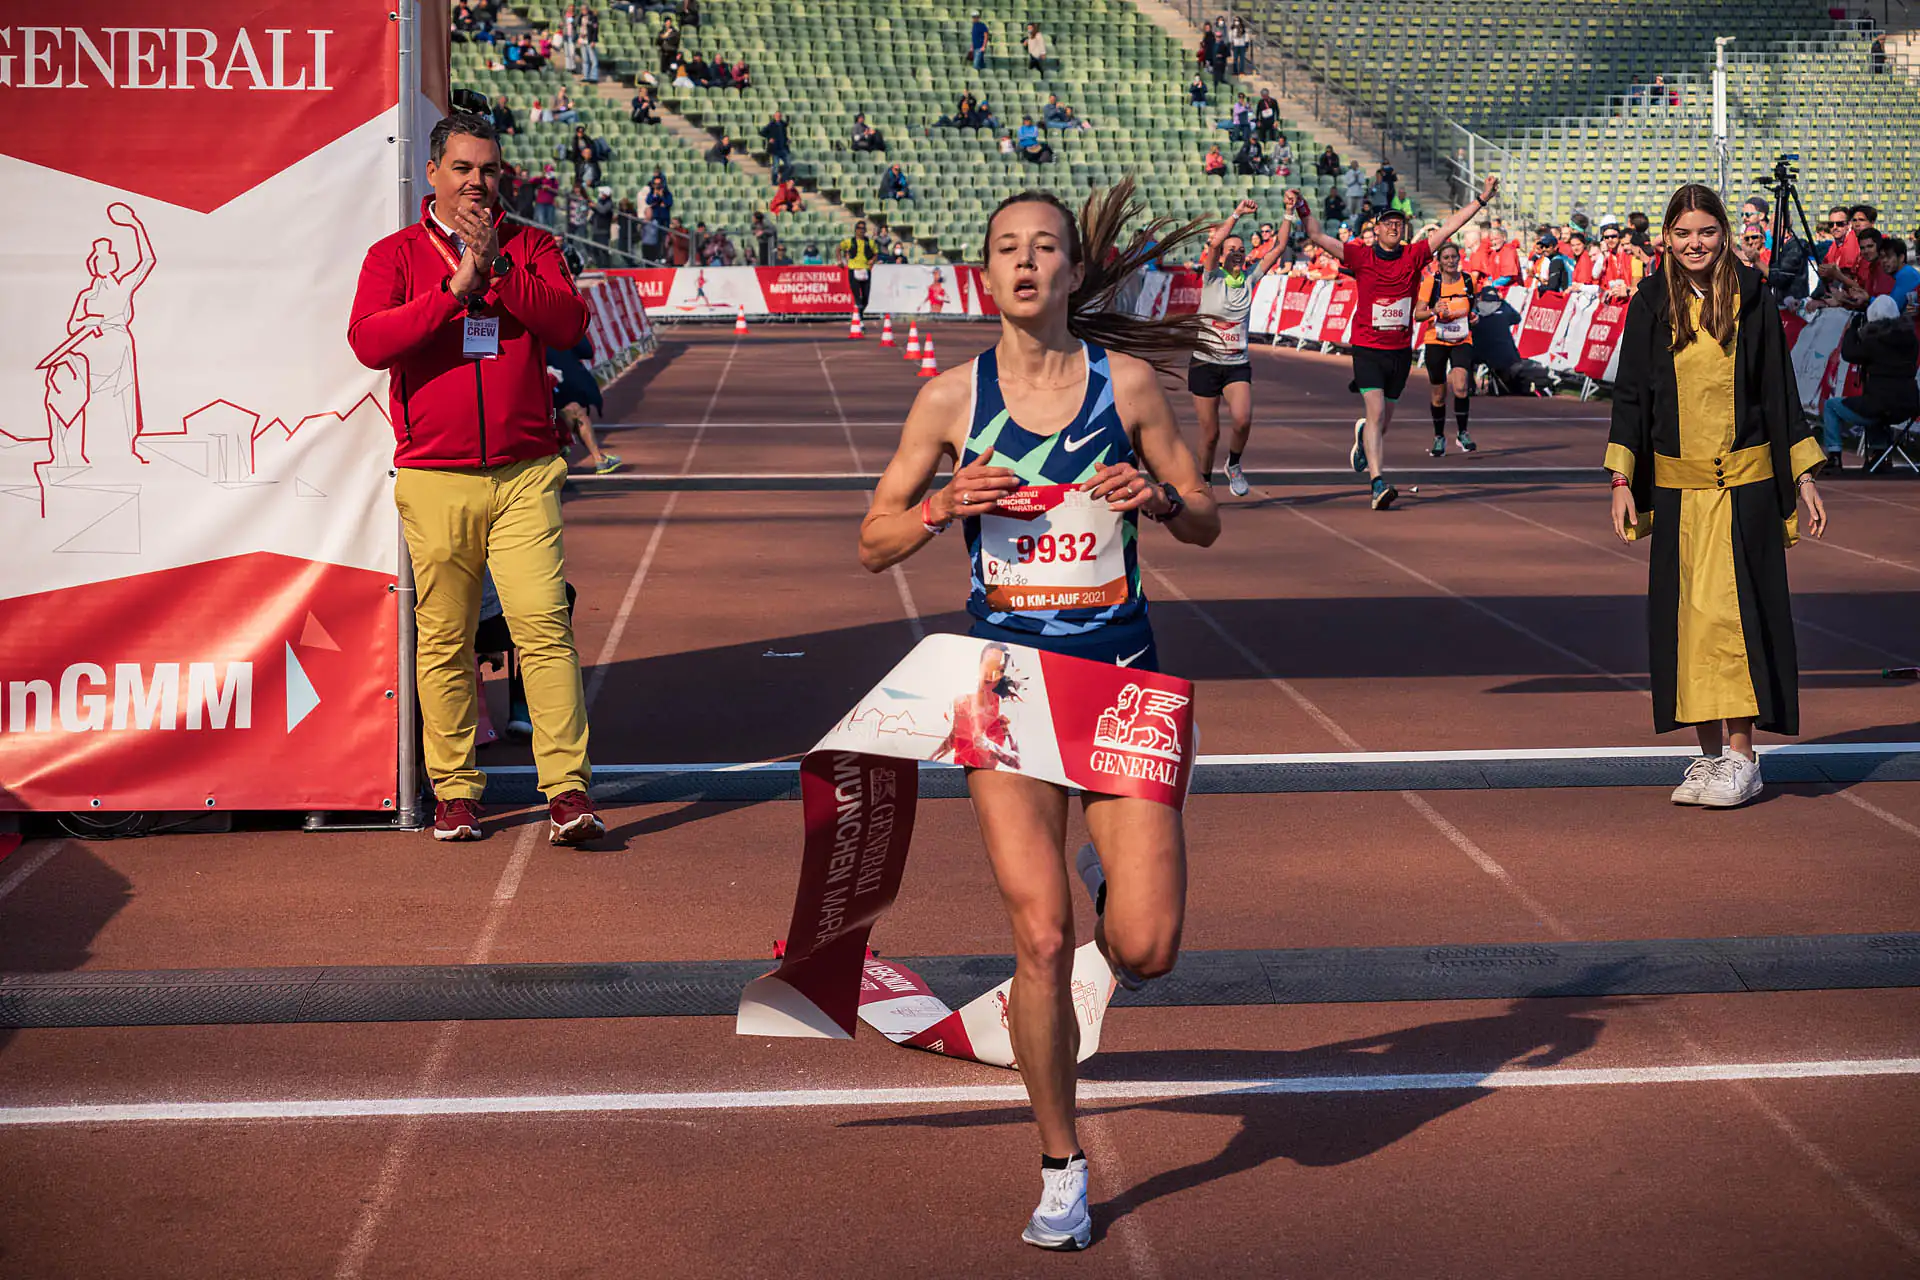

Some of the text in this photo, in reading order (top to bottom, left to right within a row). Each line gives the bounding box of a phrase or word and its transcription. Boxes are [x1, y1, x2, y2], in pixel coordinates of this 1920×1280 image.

[791, 293, 852, 305] MARATHON
[1381, 308, 1404, 318] 2386
[467, 326, 496, 337] CREW
[1016, 532, 1098, 565] 9932
[1009, 591, 1106, 608] 10 KM-LAUF 2021
[0, 661, 253, 733] nGMM
[1090, 750, 1180, 787] GENERALI
[827, 753, 863, 885] MÜNCHEN
[855, 804, 893, 896] GENERALI
